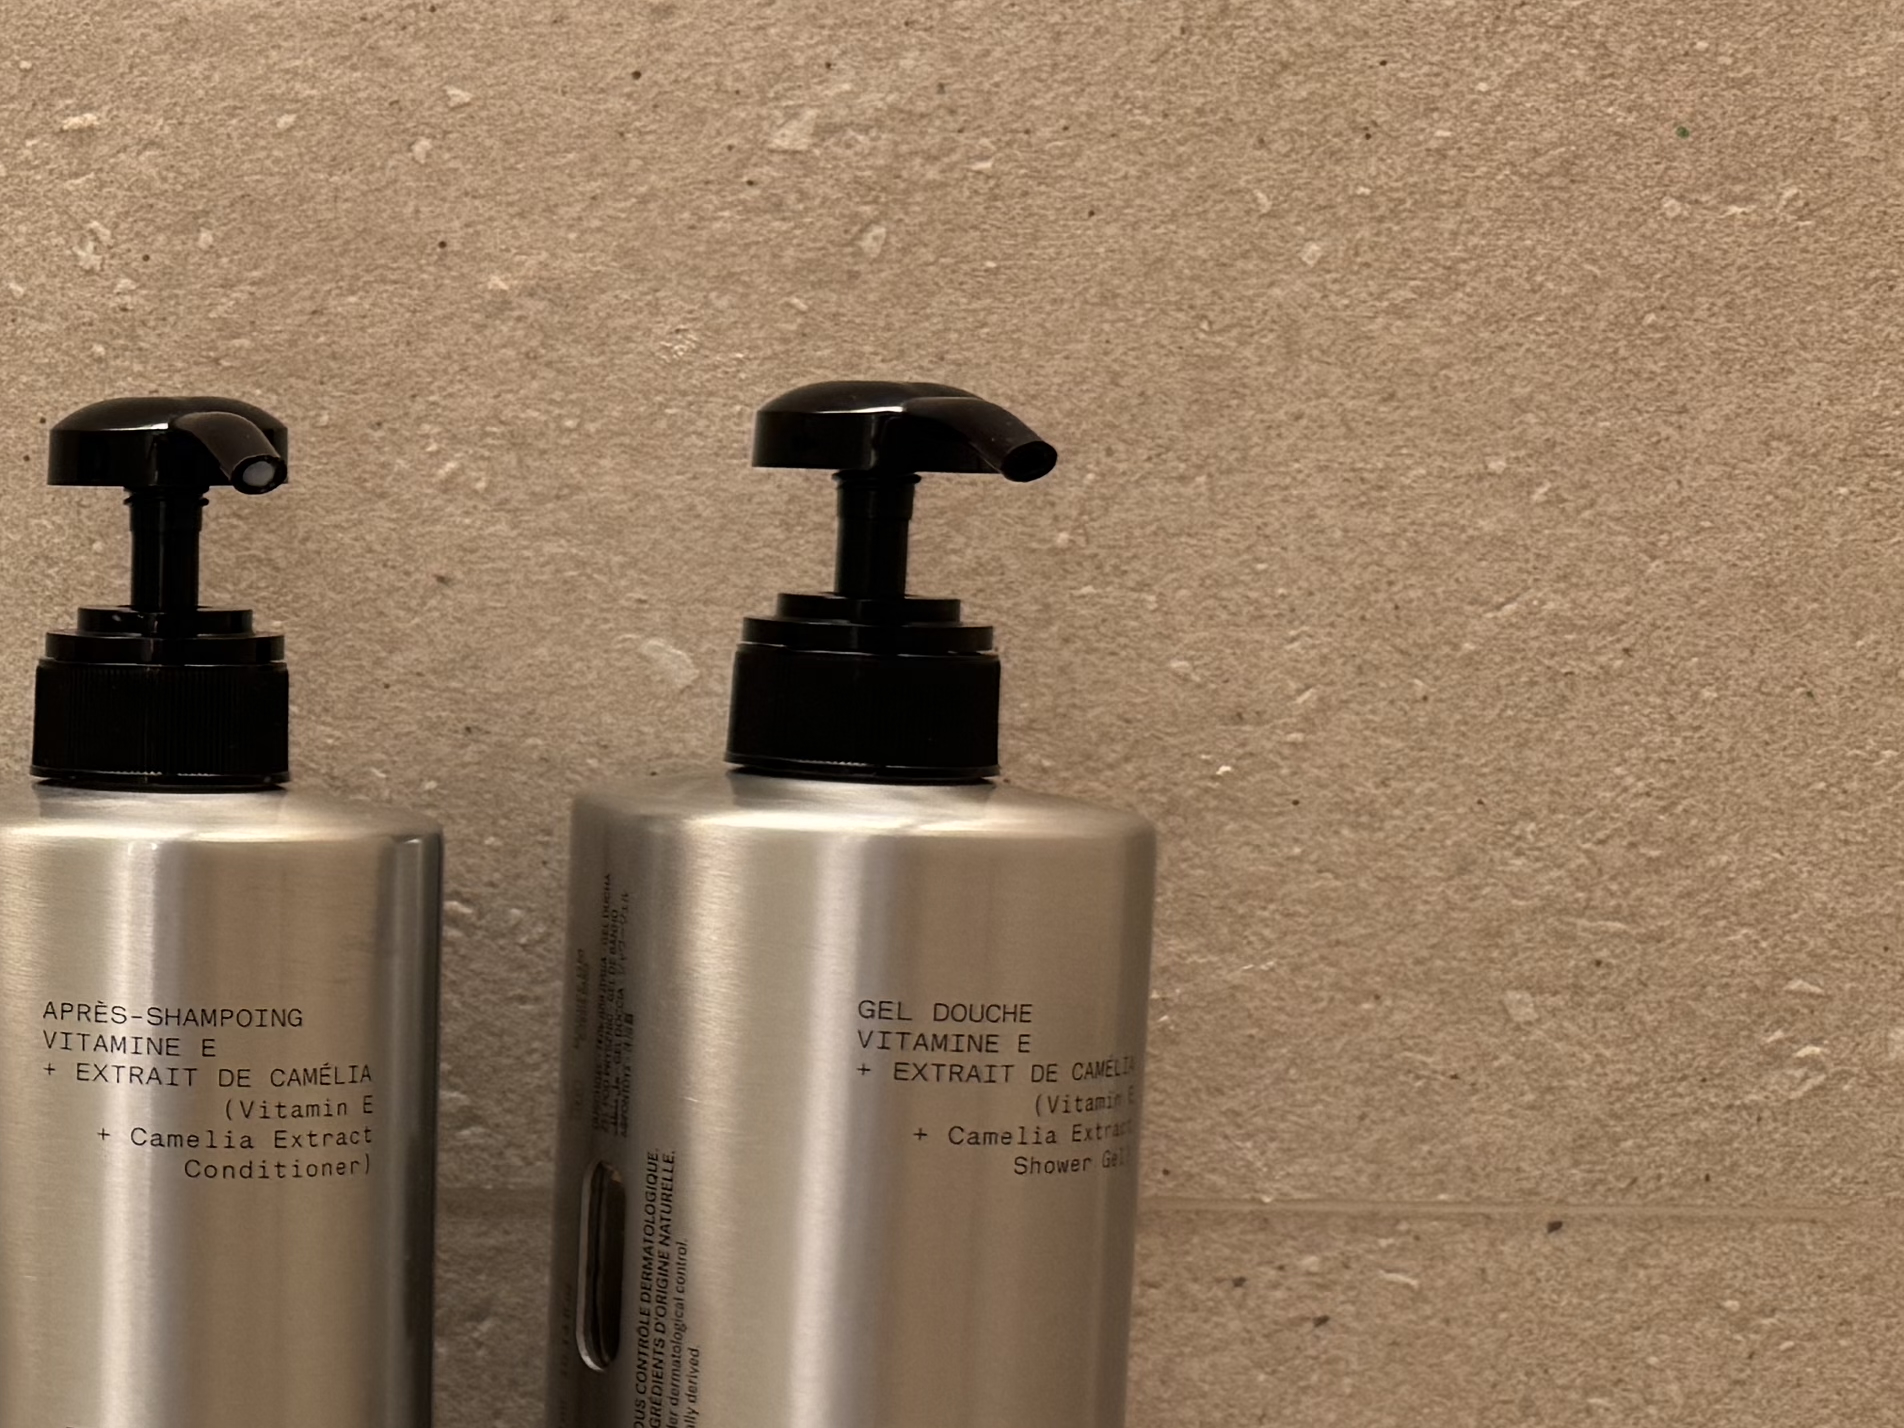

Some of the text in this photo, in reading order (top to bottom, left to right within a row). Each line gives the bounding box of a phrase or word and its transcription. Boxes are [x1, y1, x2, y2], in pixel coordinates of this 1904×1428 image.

[43, 1001, 303, 1027] APRÈS-SHAMPOING
[858, 1000, 1033, 1023] GEL DOUCHE
[43, 1030, 216, 1057] VITAMINE E
[858, 1030, 1031, 1053] VITAMINE E
[76, 1063, 197, 1087] EXTRAIT
[219, 1068, 251, 1088] DE
[270, 1063, 372, 1087] CAMÉLIA
[893, 1062, 1015, 1083] EXTRAIT
[1031, 1064, 1058, 1083] DE
[226, 1095, 374, 1120] (Vitamin E
[130, 1127, 254, 1149] Camelia
[274, 1126, 373, 1149] Extract
[948, 1126, 1057, 1146] Camelia
[184, 1153, 370, 1179] Conditioner)
[1014, 1156, 1091, 1175] Shower
[659, 1150, 675, 1248] NATURELLE.
[654, 1250, 670, 1335] D'ORIGINE
[635, 1307, 651, 1395] CONTRÔLE
[668, 1297, 688, 1407] dermatological
